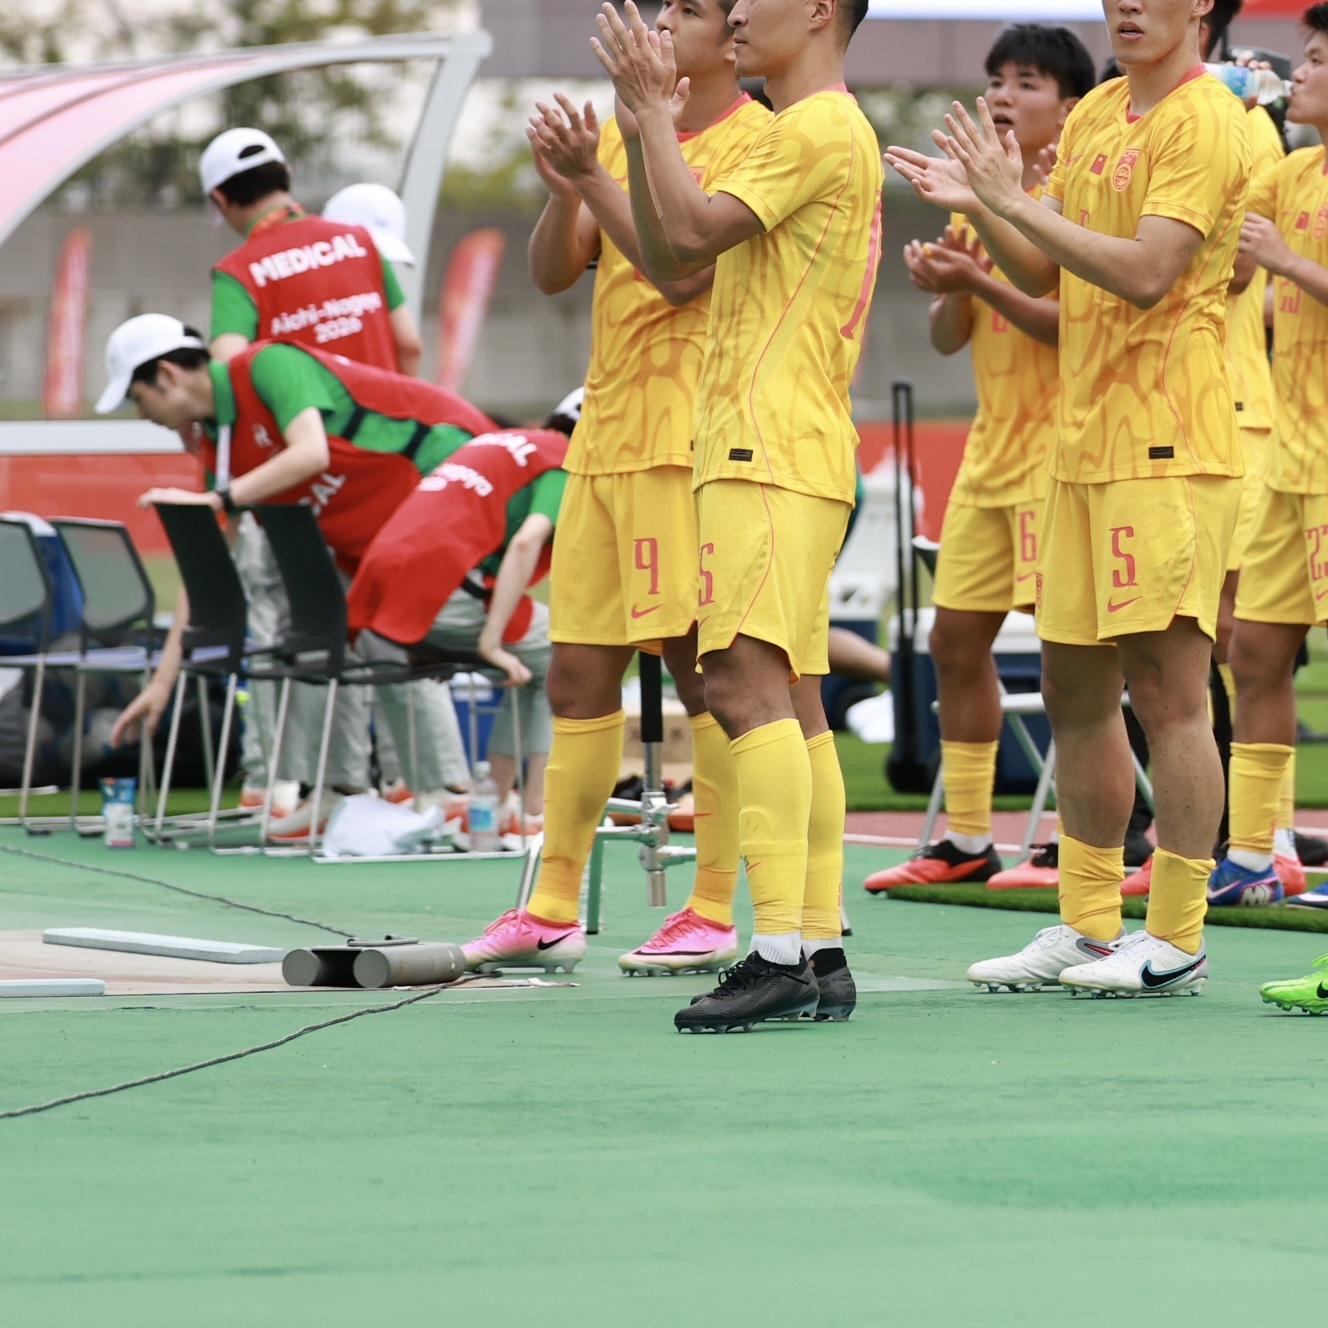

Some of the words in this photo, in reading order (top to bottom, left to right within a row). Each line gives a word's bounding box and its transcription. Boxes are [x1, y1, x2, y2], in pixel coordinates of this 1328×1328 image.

[249, 233, 367, 287] MEDICAL
[313, 316, 363, 343] 2026
[1019, 510, 1037, 563] 6
[1109, 525, 1138, 588] 5
[633, 537, 660, 595] 9
